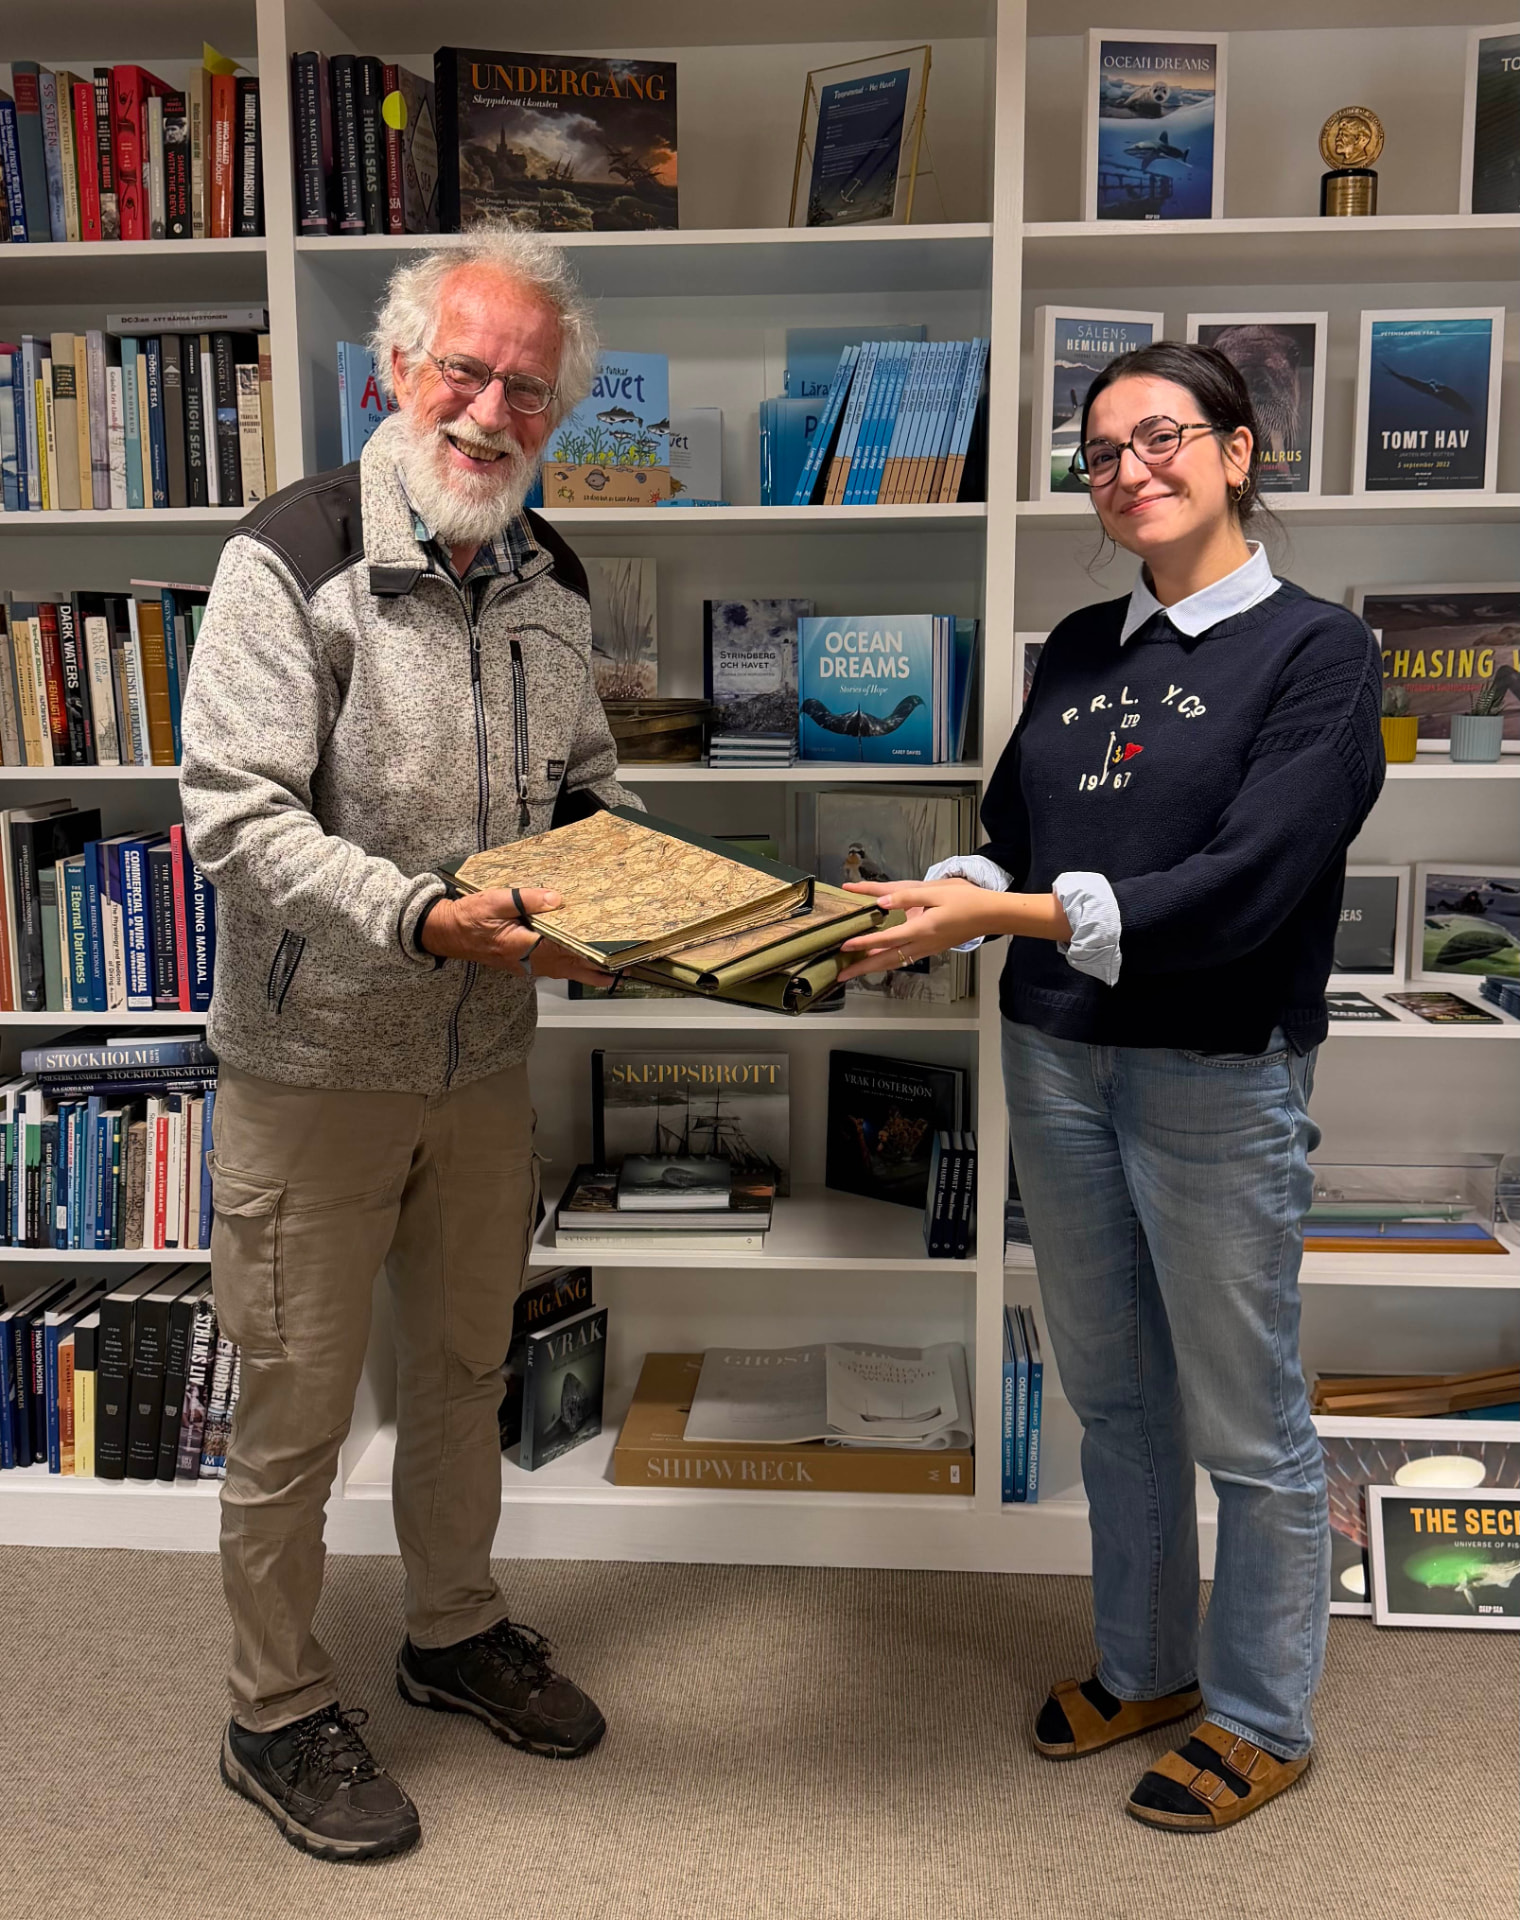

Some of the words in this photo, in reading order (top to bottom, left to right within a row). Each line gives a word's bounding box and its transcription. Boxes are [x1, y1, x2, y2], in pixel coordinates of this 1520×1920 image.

[1104, 56, 1150, 69] OCEAN
[1155, 57, 1210, 71] DREAMS
[43, 84, 54, 98] SS
[81, 89, 87, 100] ON
[472, 63, 668, 101] UNDERGÅNG
[244, 94, 256, 130] MORDET
[308, 89, 316, 115] BLUE
[345, 92, 353, 118] BLUE
[472, 95, 521, 108] Skeppsbrott
[526, 98, 558, 108] konsten
[45, 104, 58, 148] STATEN
[244, 132, 257, 143] PÅ
[364, 117, 375, 154] HIGH
[310, 119, 318, 165] MACHINE
[348, 122, 356, 168] MACHINE
[243, 146, 256, 216] HAMMARSKJÖLD
[366, 159, 376, 192] SEAS
[389, 197, 401, 209] SEA
[1067, 339, 1114, 353] HEMLIGA
[1120, 342, 1136, 353] LIV
[148, 354, 157, 385] DÖDLIG
[216, 338, 225, 403] SHANGRI-LA
[150, 388, 158, 408] RESA
[591, 375, 645, 403] avet
[189, 395, 199, 430] HIGH
[190, 435, 201, 467] SEAS
[1382, 430, 1428, 450] TOMT
[1435, 429, 1470, 448] HAV
[1403, 461, 1434, 469] september
[60, 606, 72, 639] DARK
[720, 650, 776, 660] STRINDBERG
[825, 631, 902, 654] OCEAN
[63, 641, 79, 688] WATERS
[125, 649, 137, 697] NAUTISKT
[819, 656, 910, 679] DREAMS
[1382, 649, 1493, 678] CHASING
[48, 680, 60, 716] FIENTLIGT
[840, 684, 861, 694] Stories
[863, 684, 870, 694] of
[870, 684, 888, 696] Hope
[1090, 694, 1113, 712] R.
[1121, 686, 1139, 704] L.
[52, 718, 62, 734] HAV
[129, 698, 143, 763] BILDLEXIKON
[1120, 714, 1140, 728] LTD
[1078, 774, 1098, 791] 19
[1113, 772, 1132, 789] 67
[124, 850, 132, 890] Richard
[130, 850, 143, 913] COMMERCIAL
[193, 863, 206, 890] OAA
[71, 891, 85, 929] Eternal
[90, 906, 98, 938] REFERENCE
[128, 918, 134, 926] &
[195, 894, 206, 932] DIVING
[1339, 910, 1362, 922] SEAS
[112, 916, 120, 948] Physiology
[134, 916, 145, 950] DIVING
[164, 911, 173, 951] MACHINE
[74, 933, 86, 984] Darkness
[92, 941, 100, 978] DICTIONARY
[130, 950, 138, 992] Whistler
[136, 952, 147, 992] MANUAL
[196, 936, 208, 984] MANUAL
[46, 1050, 147, 1068] STOCKHOLM
[107, 1066, 216, 1080] STOCKHOLMSKARTOR
[612, 1064, 781, 1084] SKEPPSBROTT
[844, 1073, 869, 1087] VRAK
[942, 1157, 948, 1168] OM
[954, 1158, 960, 1168] OM
[968, 1159, 974, 1168] OM
[939, 1168, 947, 1189] HAVET
[965, 1170, 973, 1190] HAVET
[527, 1275, 587, 1322] RGÅNG
[35, 1330, 43, 1348] HANS
[191, 1314, 211, 1363] STHLMS
[546, 1318, 604, 1362] VRAK
[724, 1352, 810, 1366] GHOST
[36, 1366, 44, 1394] HOFSTEN
[188, 1366, 205, 1386] LIV
[211, 1355, 231, 1410] NORDEN
[1018, 1377, 1026, 1404] OCEAN
[1031, 1429, 1039, 1460] DREAMS
[647, 1456, 813, 1482] SHIPWRECK
[1029, 1462, 1037, 1490] OCEAN
[1410, 1507, 1458, 1534] THE
[1479, 1605, 1491, 1613] DEEP
